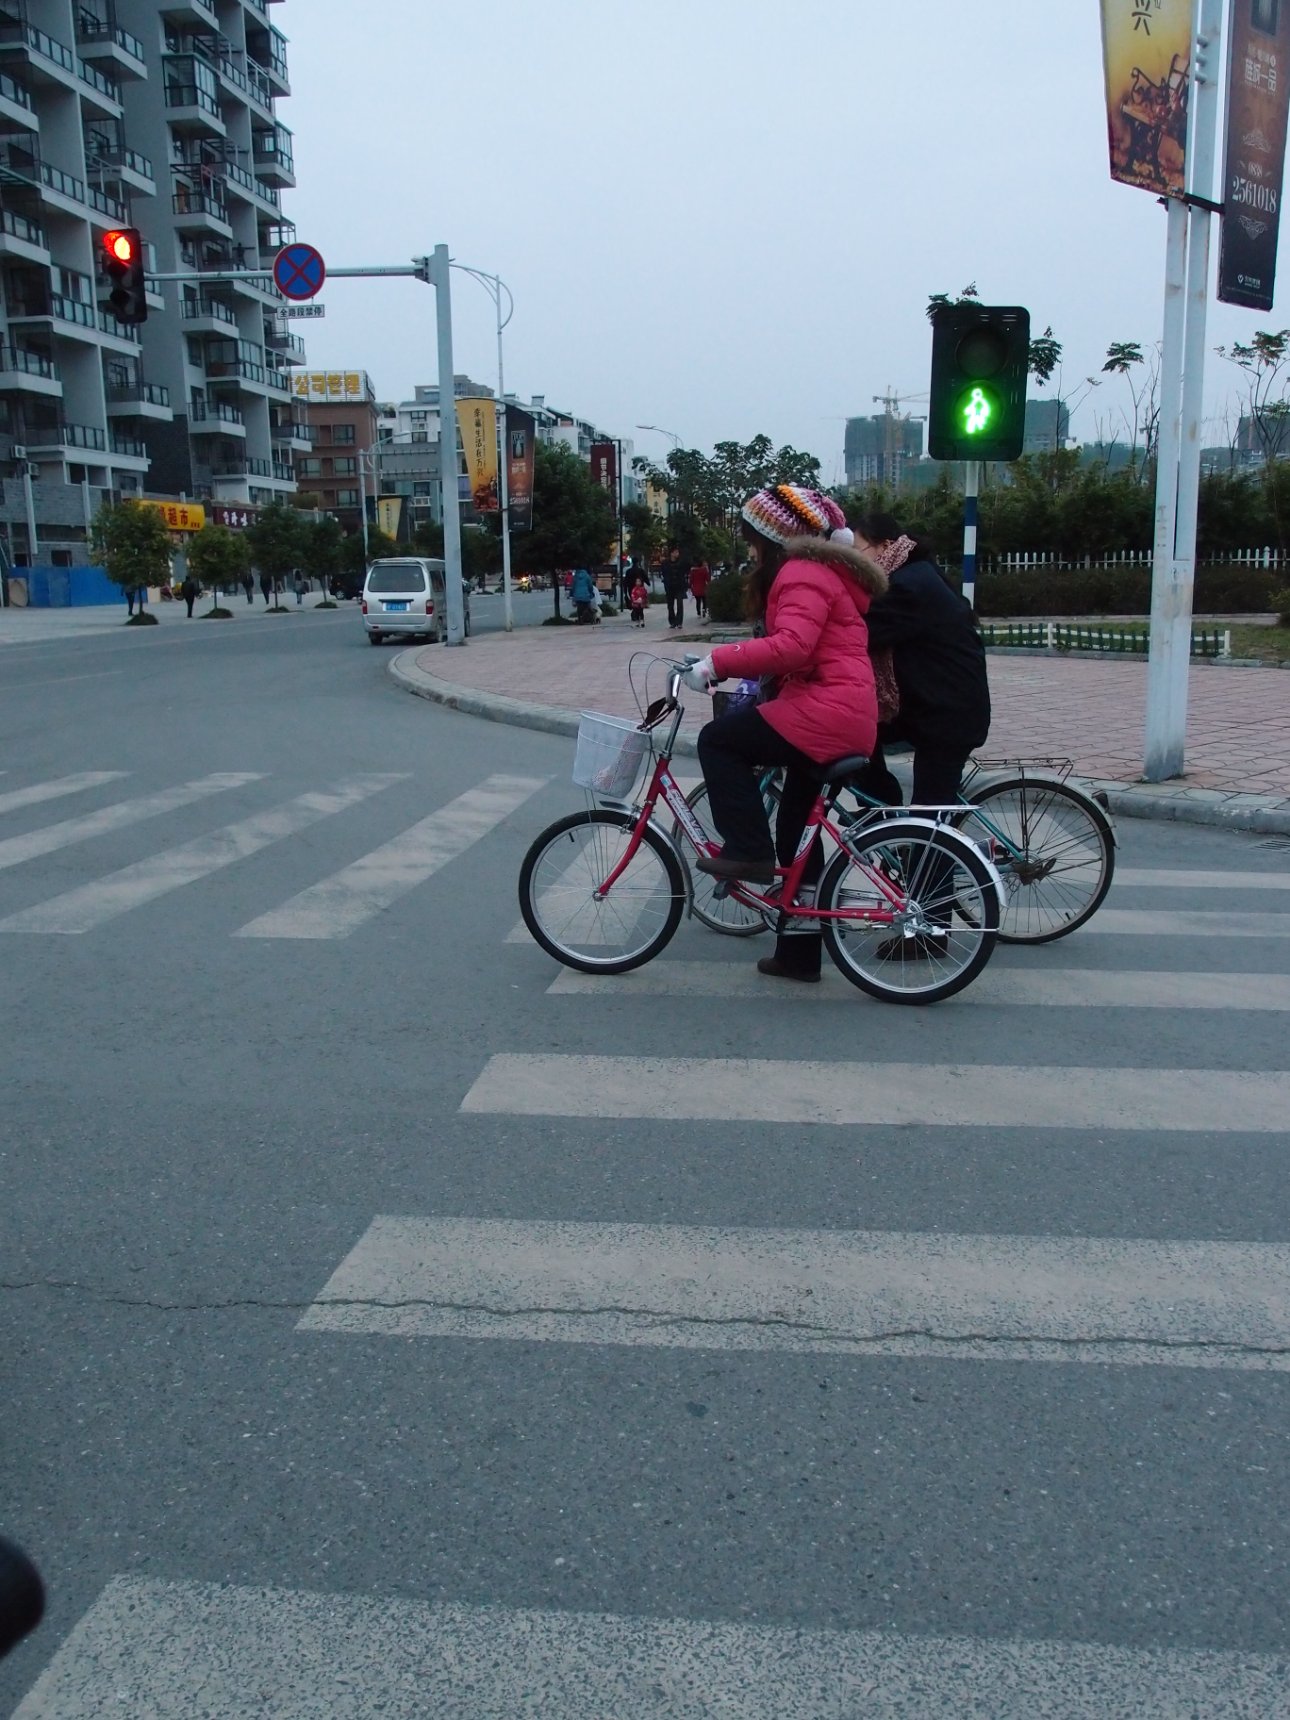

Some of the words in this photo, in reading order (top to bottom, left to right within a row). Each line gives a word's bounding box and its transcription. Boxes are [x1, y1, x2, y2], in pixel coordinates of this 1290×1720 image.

[1232, 175, 1277, 213] 2561018
[280, 307, 322, 317] 全路段禁停
